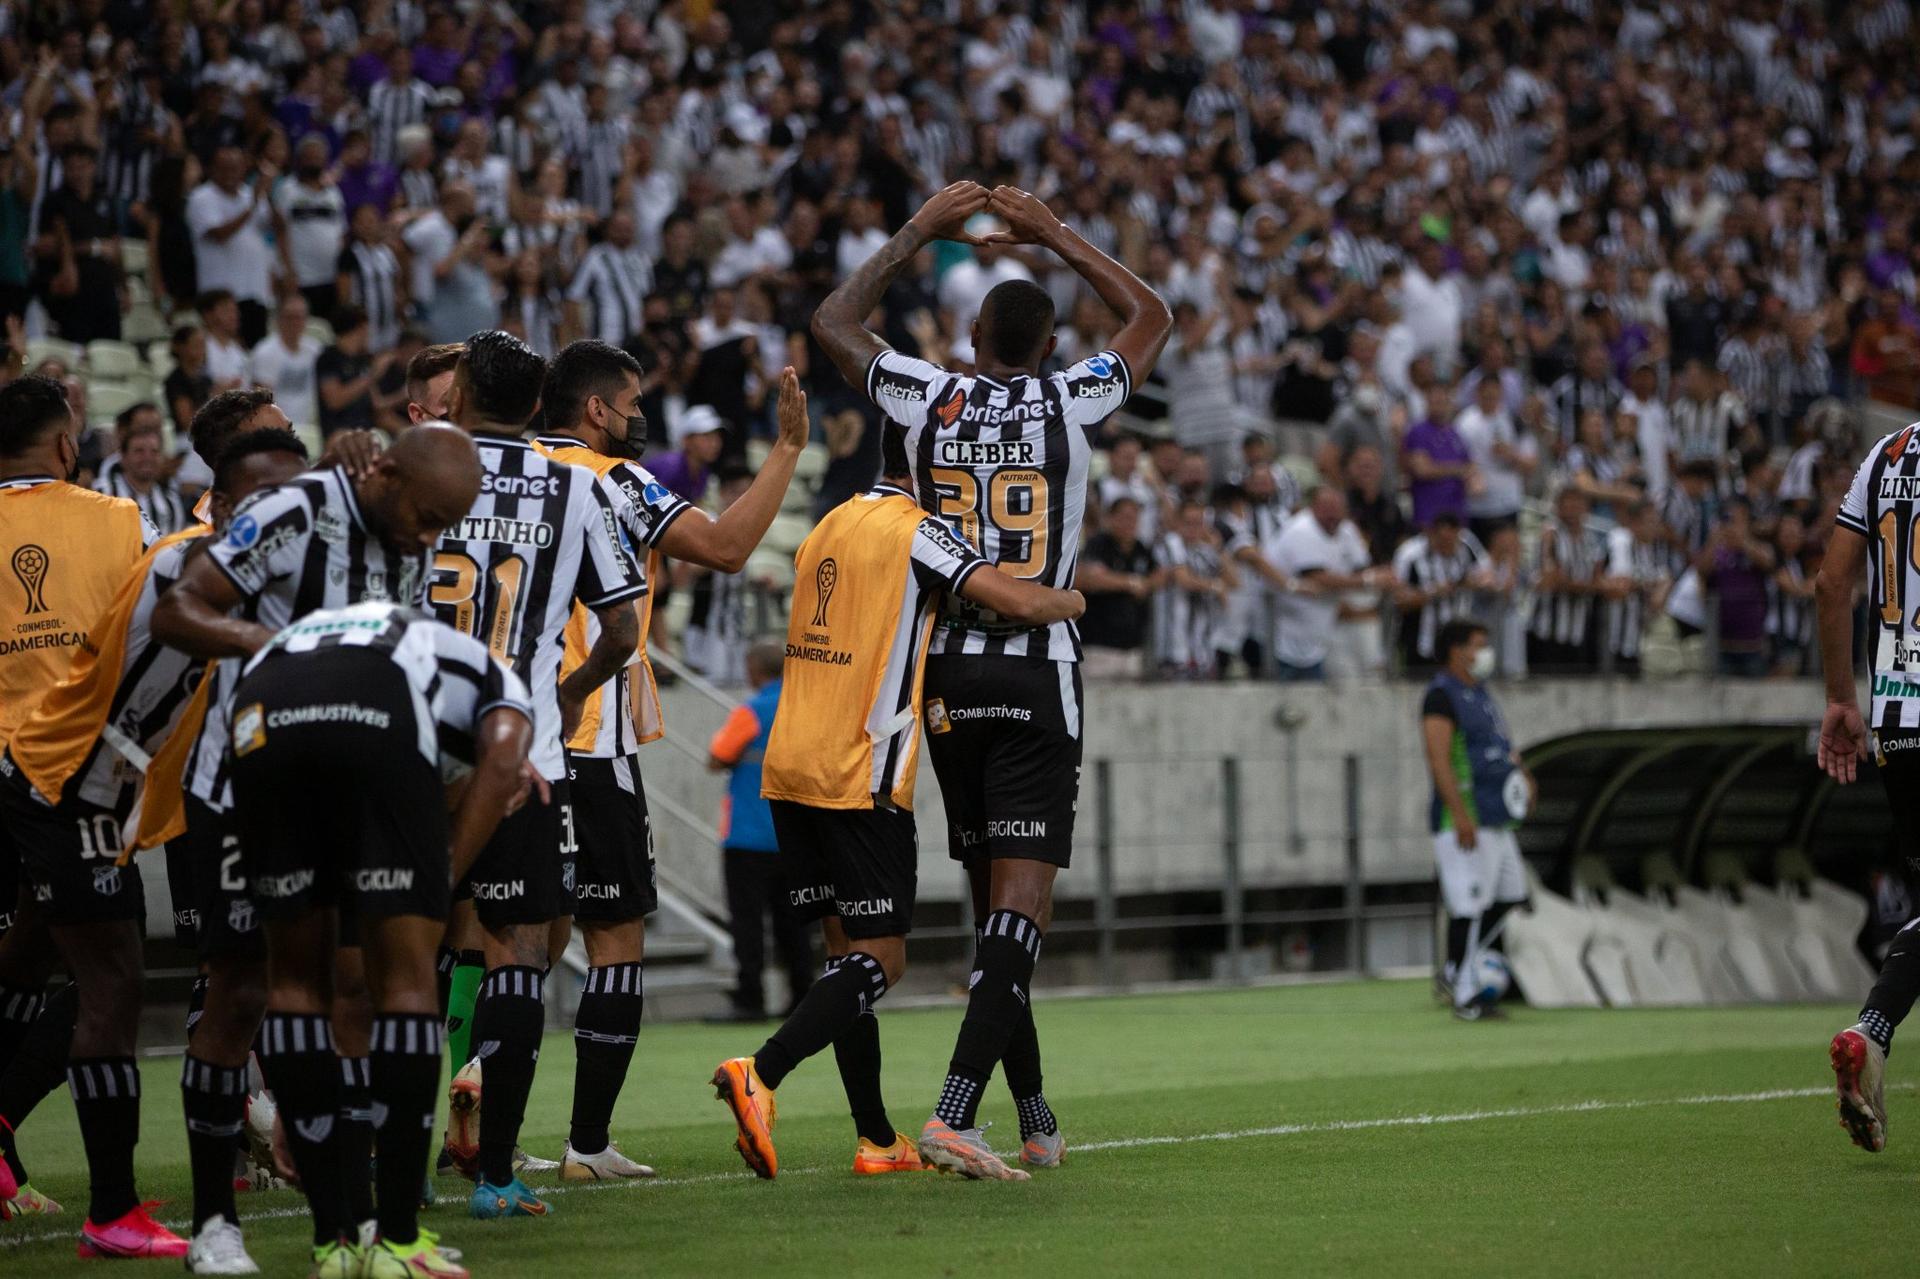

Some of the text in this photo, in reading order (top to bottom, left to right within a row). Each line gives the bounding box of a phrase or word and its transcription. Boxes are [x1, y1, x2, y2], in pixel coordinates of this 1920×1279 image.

[961, 399, 1054, 425] brisanet
[941, 441, 1034, 464] CLEBER
[1000, 473, 1039, 483] NUTRATA
[929, 467, 1049, 579] 39
[602, 507, 631, 576] betcris
[430, 553, 521, 668] 31
[17, 619, 61, 634] CONMEBOL
[267, 703, 391, 729] COMBUSTÍVEIS
[950, 704, 1032, 721] COMBUSTÍVEIS
[78, 813, 123, 860] 10
[560, 804, 579, 854] 31
